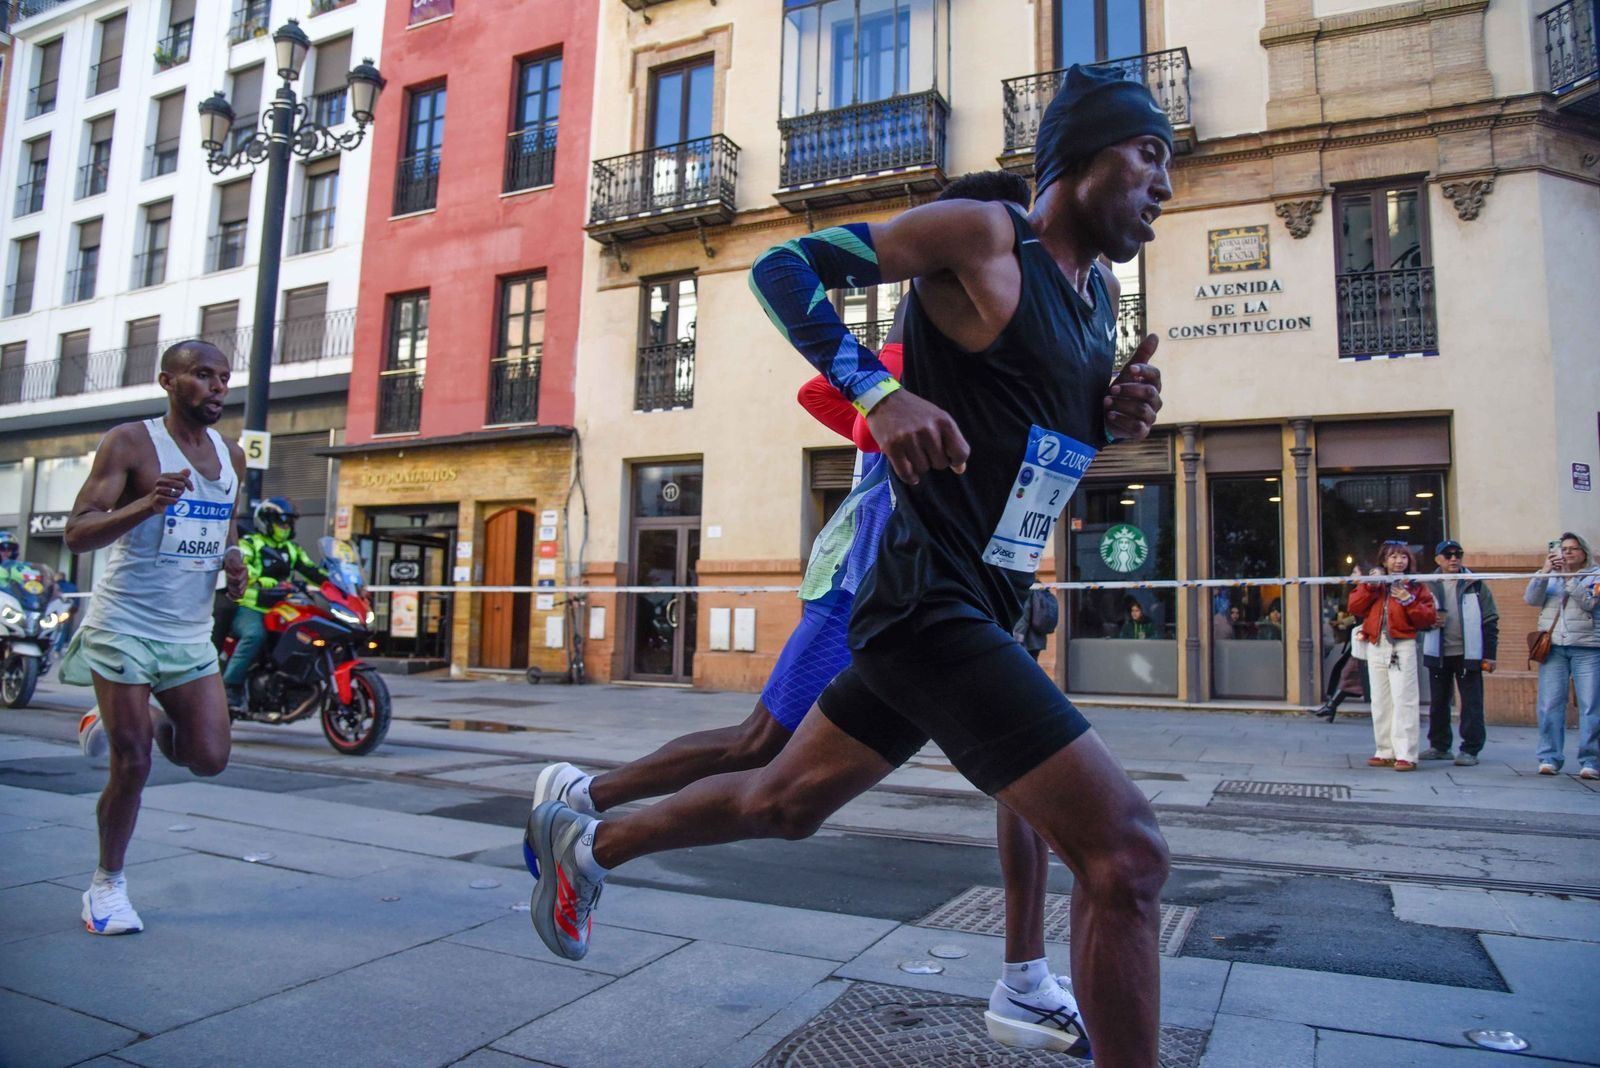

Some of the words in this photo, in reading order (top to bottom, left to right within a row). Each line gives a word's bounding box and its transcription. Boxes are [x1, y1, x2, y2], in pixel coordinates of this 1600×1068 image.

[1196, 279, 1281, 298] AVENIDA
[1211, 304, 1235, 317] DE
[1244, 300, 1268, 314] LA
[1168, 316, 1311, 339] CONSTITUCION
[248, 440, 262, 458] 5
[1048, 489, 1060, 506] 2
[200, 527, 208, 537] 3
[1019, 510, 1058, 541] KITA
[176, 540, 220, 555] ASRAR
